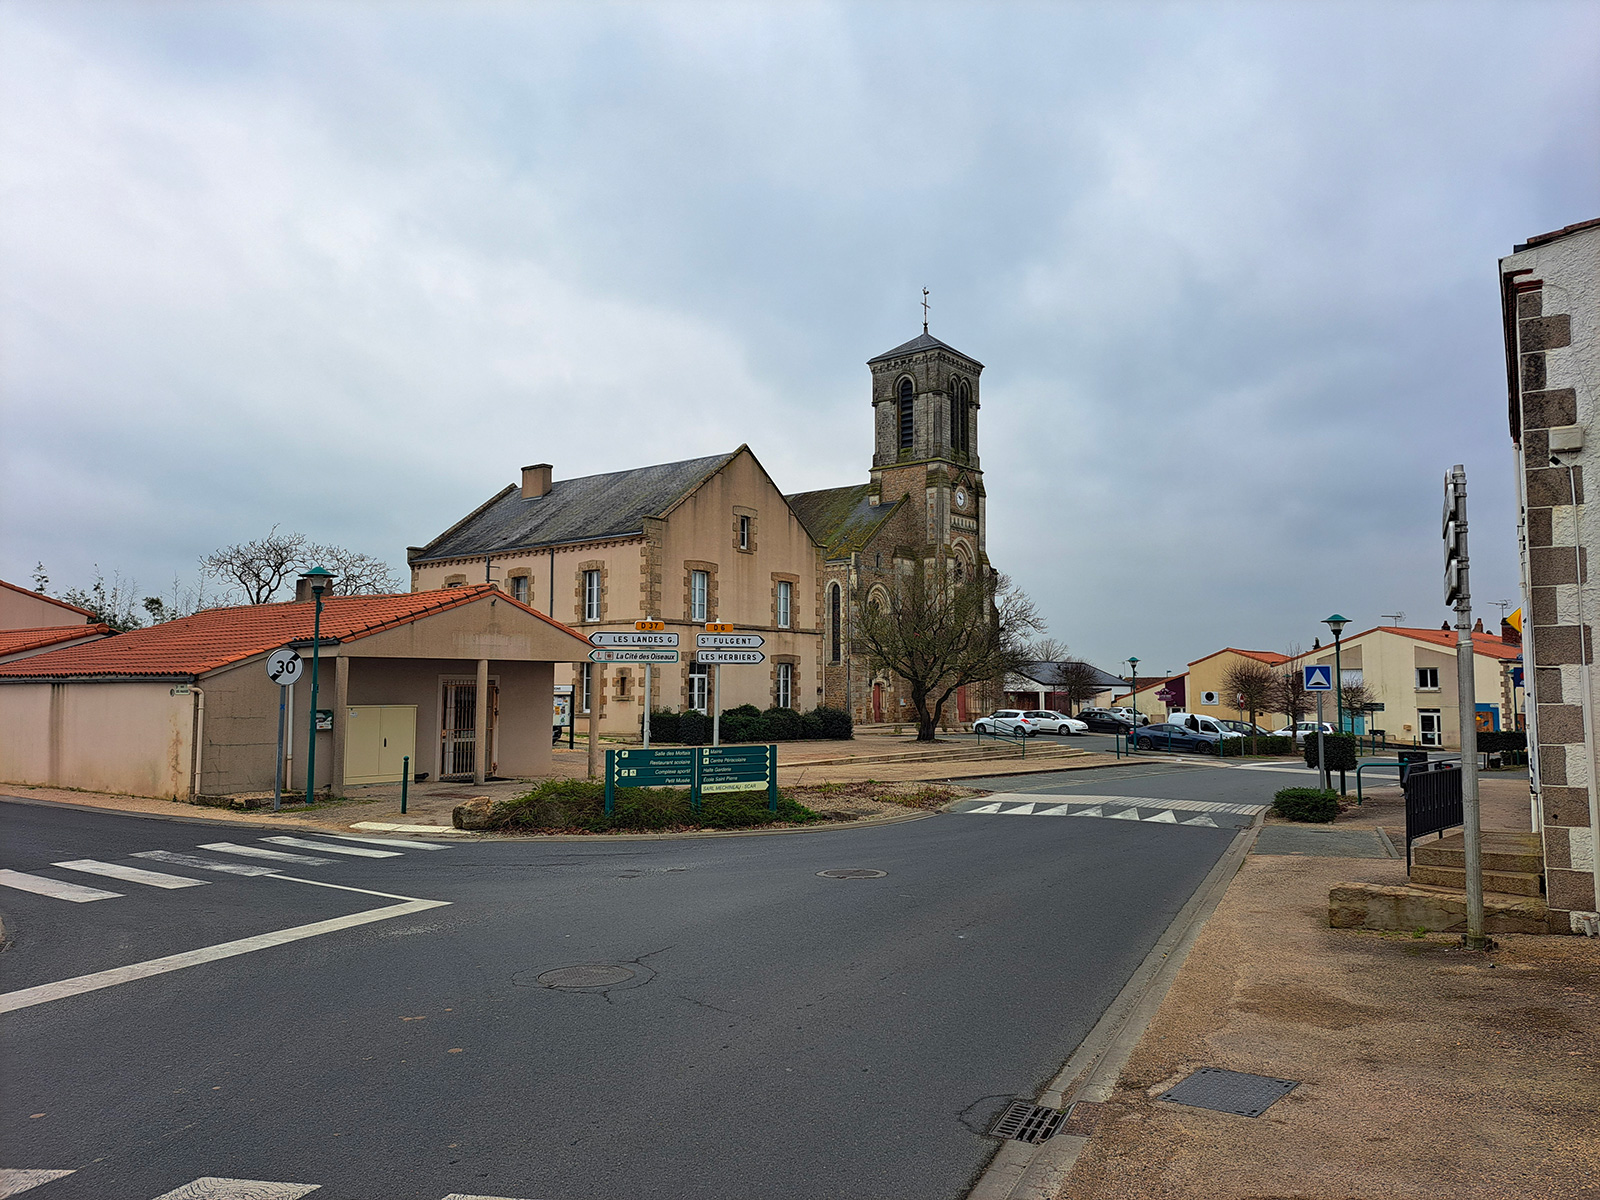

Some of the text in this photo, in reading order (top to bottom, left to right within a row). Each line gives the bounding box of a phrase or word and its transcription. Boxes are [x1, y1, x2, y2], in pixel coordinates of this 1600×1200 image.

[624, 652, 638, 660] Cité
[650, 652, 675, 660] Oiseaux
[275, 660, 296, 674] 30
